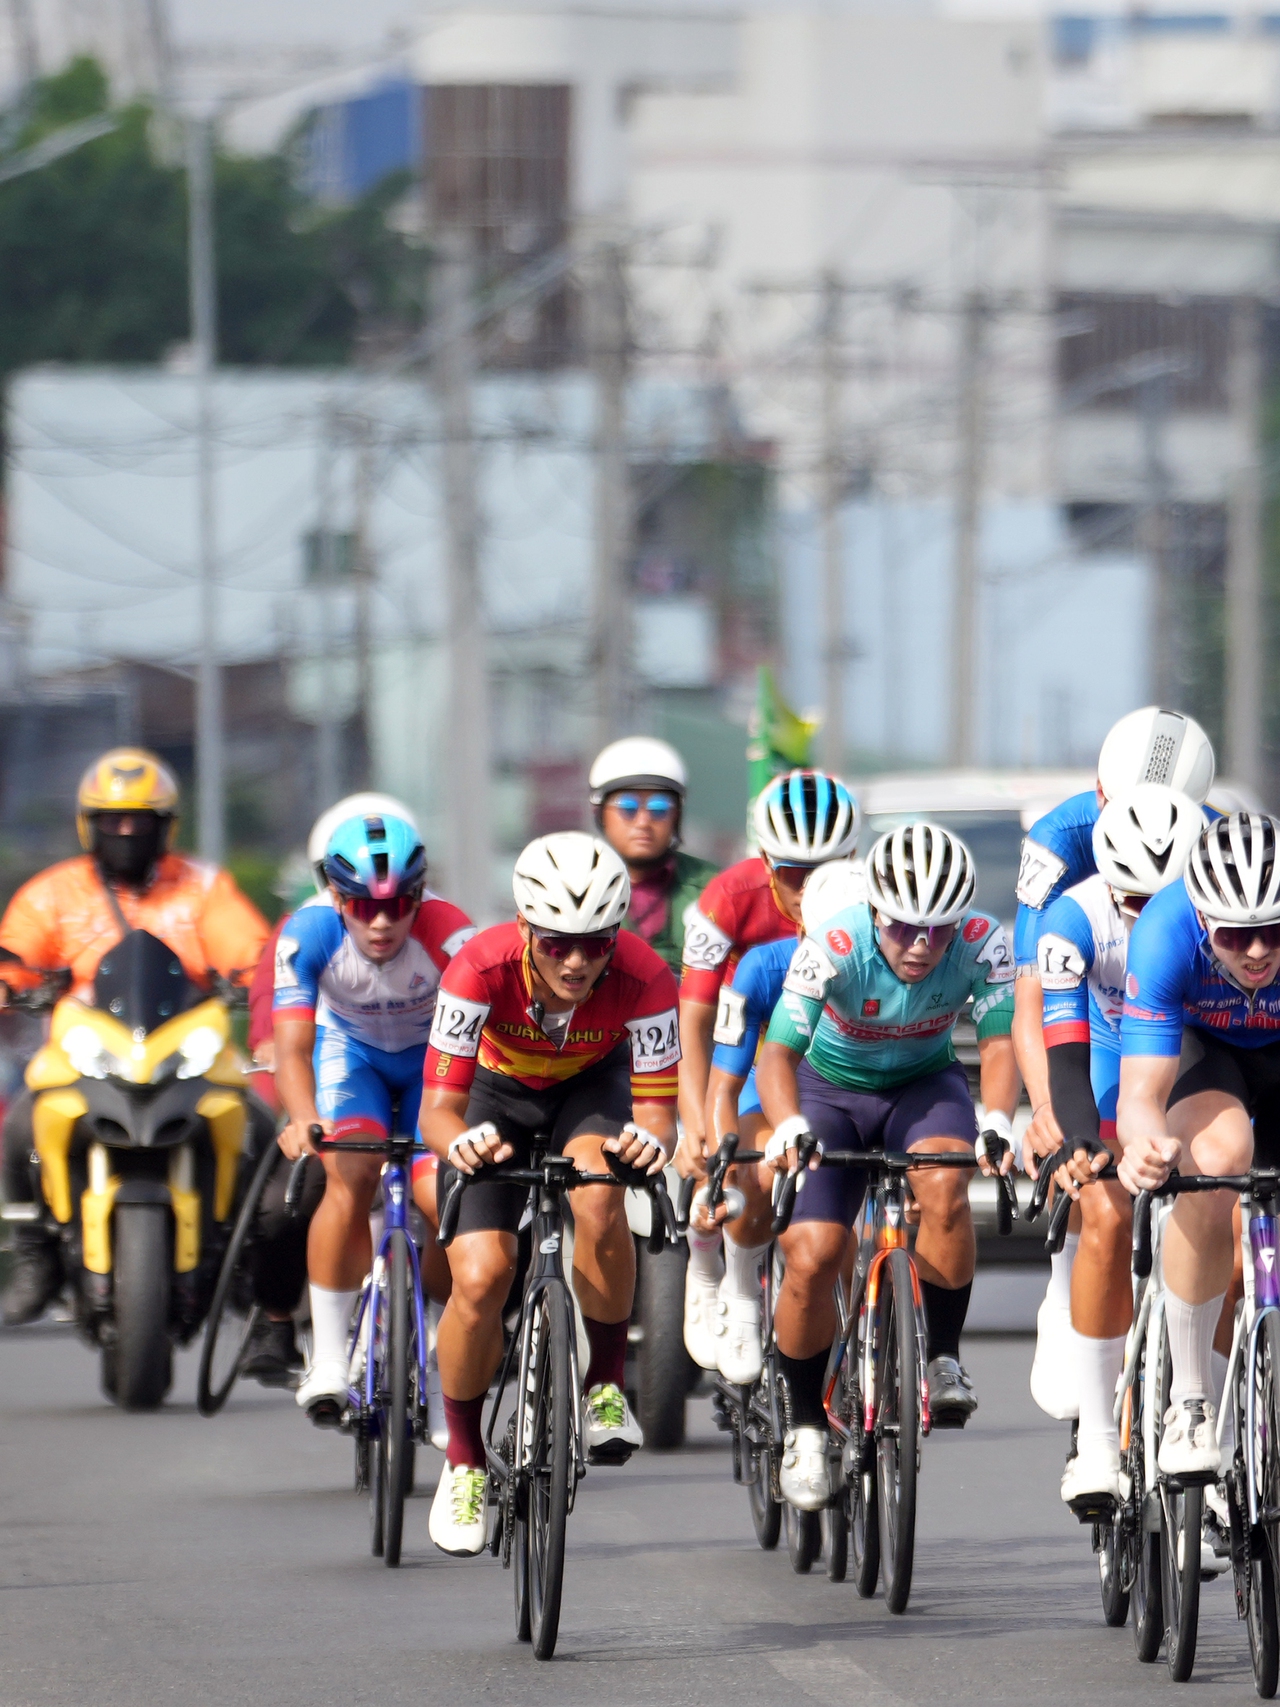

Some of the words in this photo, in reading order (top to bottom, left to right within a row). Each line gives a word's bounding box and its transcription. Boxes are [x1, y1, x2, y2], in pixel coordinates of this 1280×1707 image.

[686, 923, 723, 963] 126
[993, 945, 1014, 968] 2
[792, 949, 822, 982] 23
[436, 1003, 482, 1043] 124
[566, 1030, 604, 1044] KHU
[612, 1032, 622, 1042] 7
[635, 1019, 678, 1058] 124
[643, 1059, 659, 1068] TON
[658, 1053, 675, 1067] DONG
